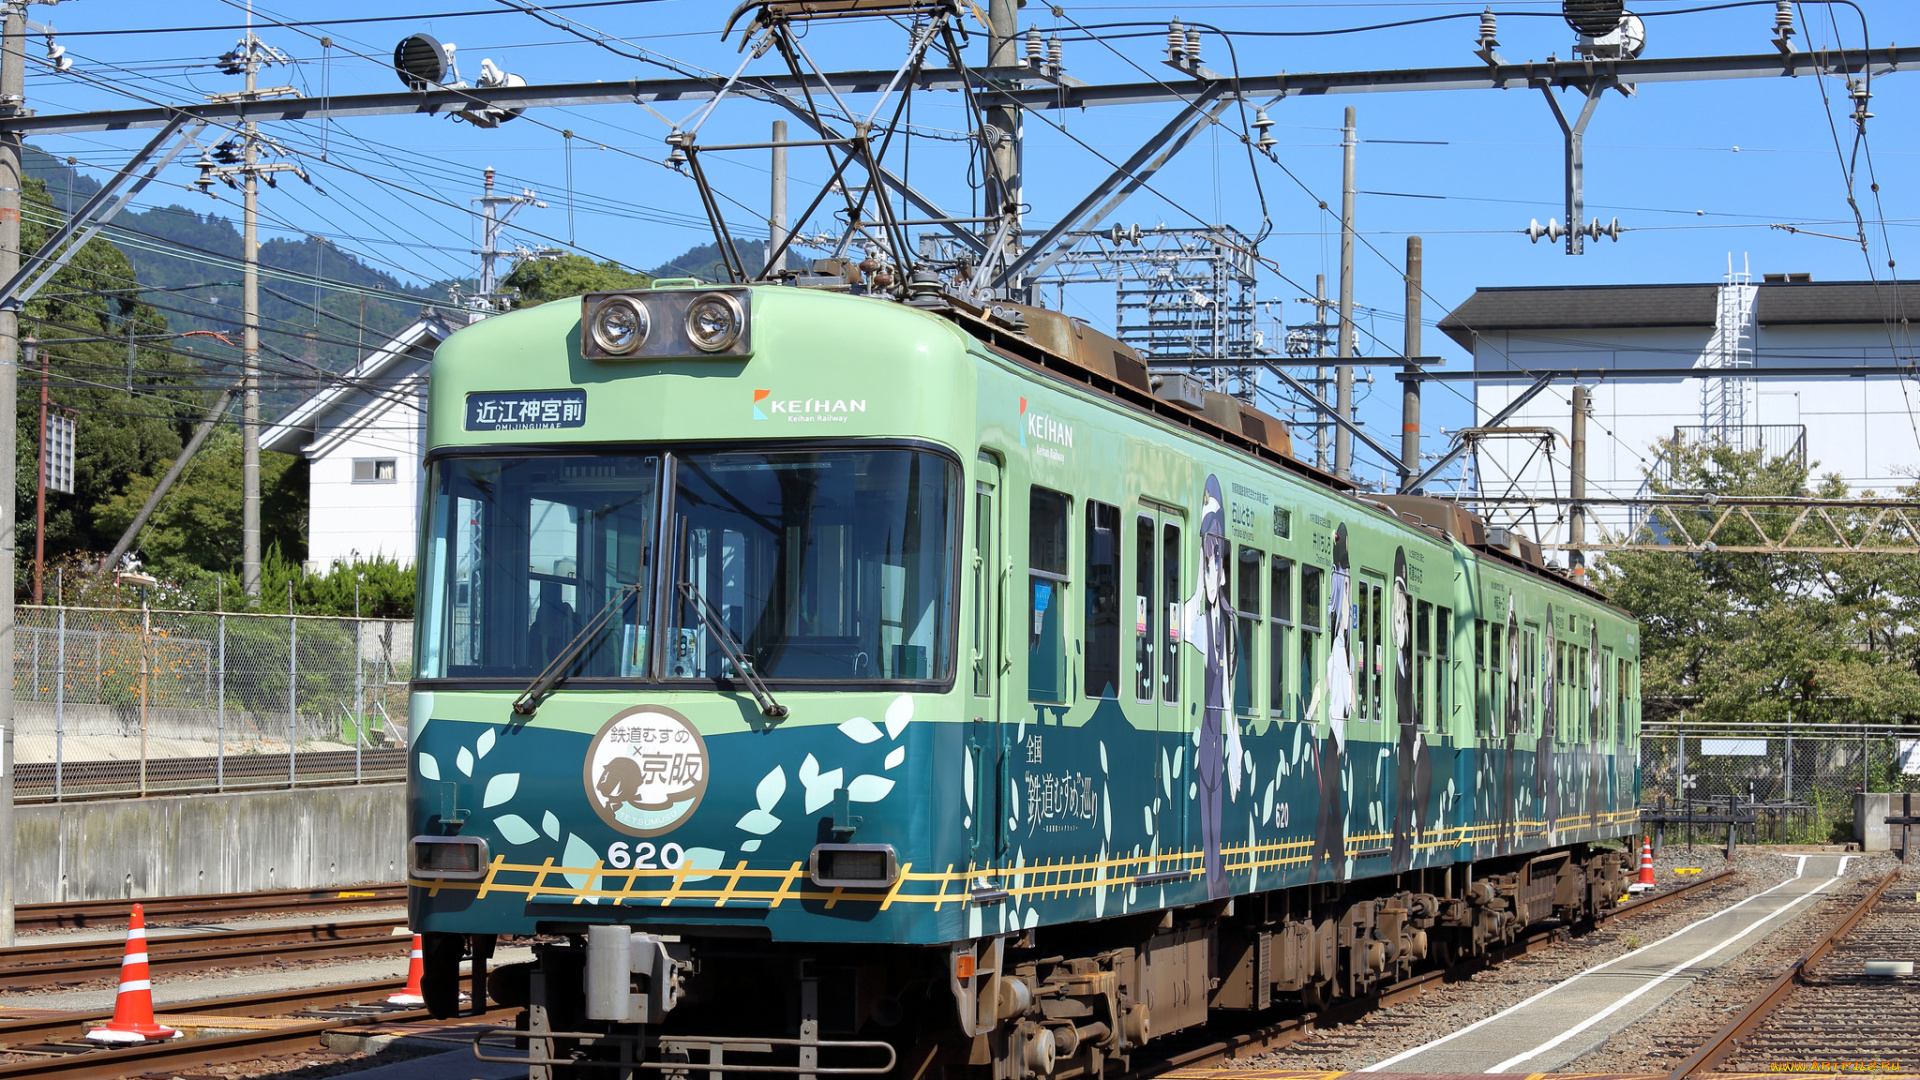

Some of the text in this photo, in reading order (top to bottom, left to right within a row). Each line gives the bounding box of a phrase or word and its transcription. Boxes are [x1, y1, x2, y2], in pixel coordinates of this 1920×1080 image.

[476, 397, 583, 424] 近江神宮前
[771, 398, 866, 413] KEIHAN
[788, 415, 848, 423] Keihan Railway
[1028, 412, 1073, 449] KEIHAN
[611, 726, 690, 744] 鉄道むすめ
[1026, 734, 1042, 764] 全国
[642, 752, 702, 786] 京阪
[1275, 802, 1289, 829] 620
[607, 841, 685, 870] 620
